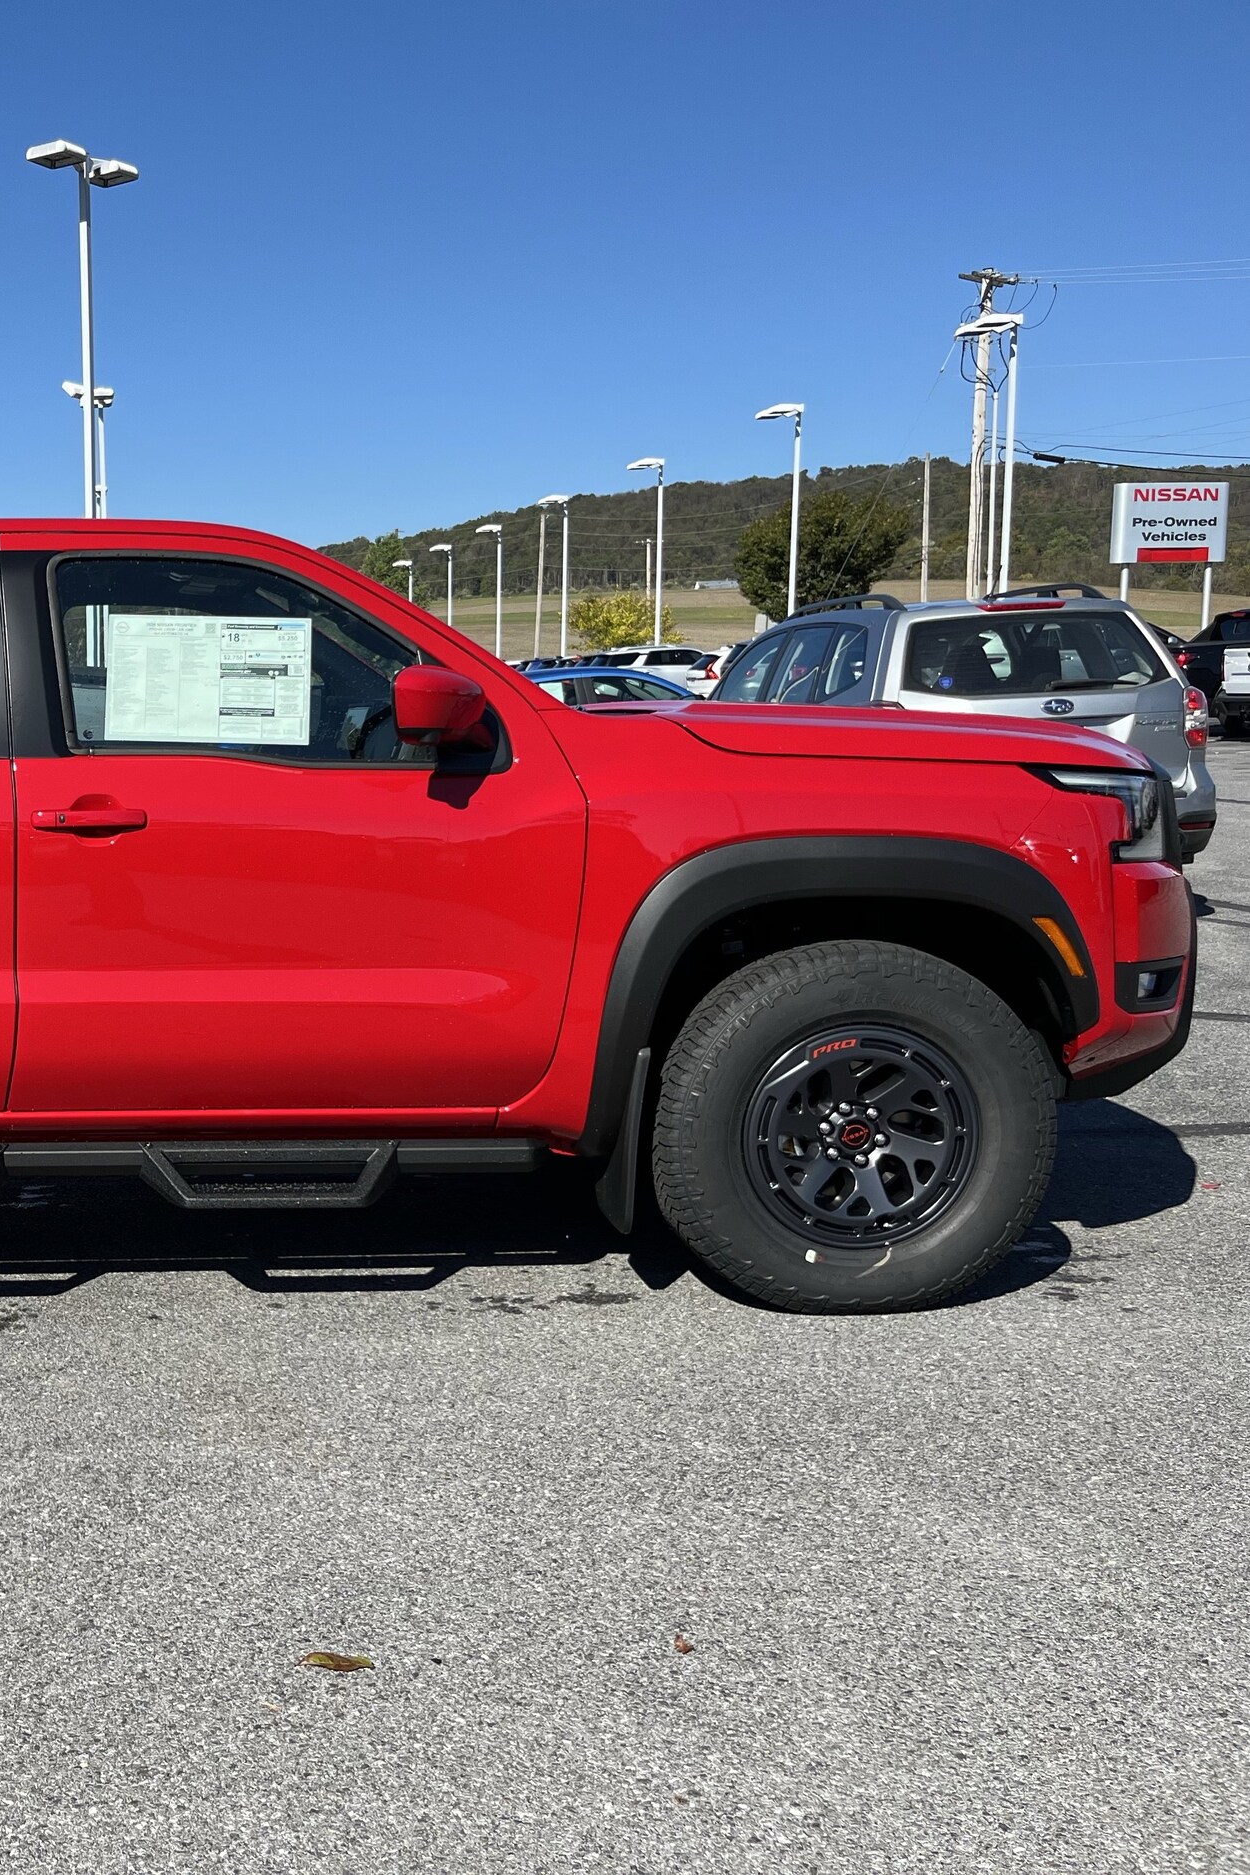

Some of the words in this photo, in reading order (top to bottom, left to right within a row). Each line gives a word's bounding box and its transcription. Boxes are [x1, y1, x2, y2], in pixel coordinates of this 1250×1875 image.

[1133, 487, 1220, 502] NISSAN
[1132, 516, 1218, 528] Pre-Owned
[1141, 531, 1207, 542] Vehicles
[227, 633, 240, 643] 18
[812, 1038, 858, 1060] PRO
[840, 1126, 870, 1143] NISSAN
